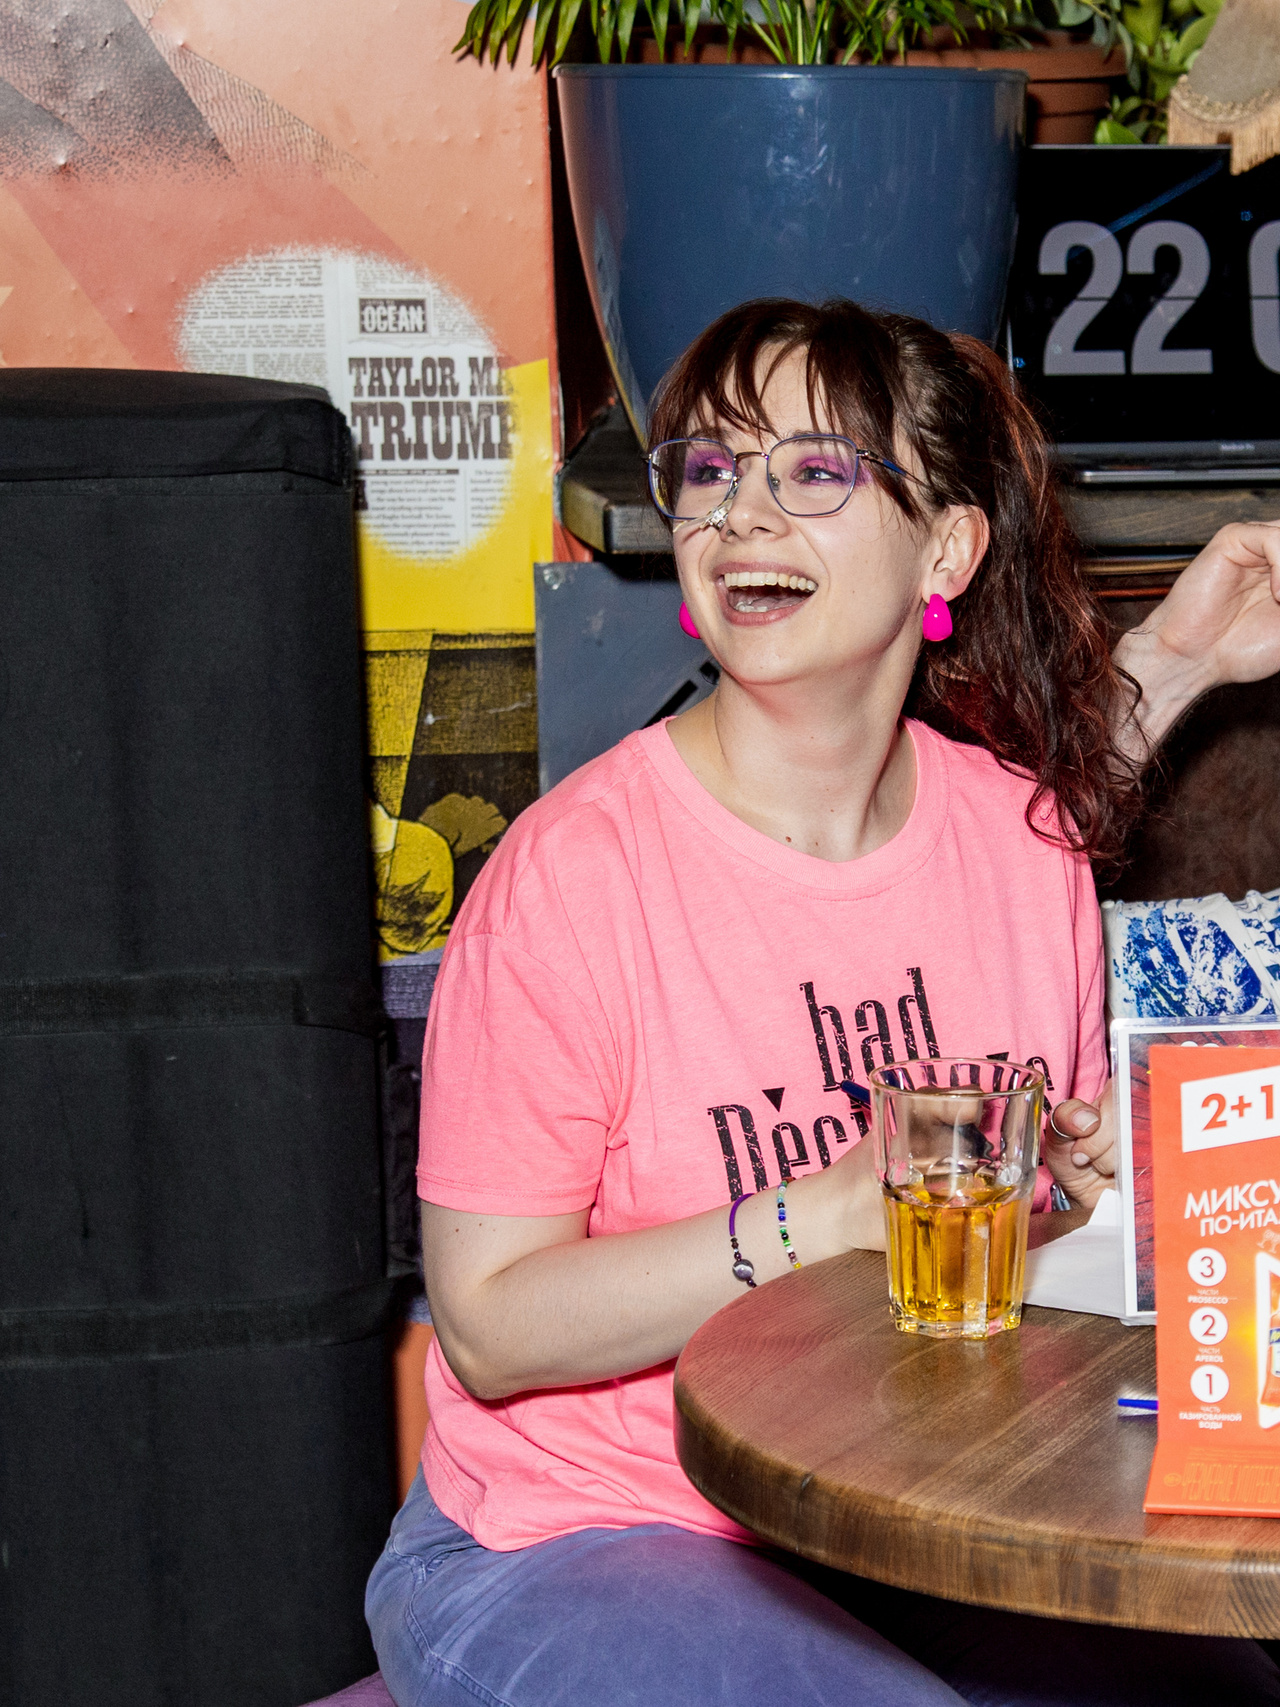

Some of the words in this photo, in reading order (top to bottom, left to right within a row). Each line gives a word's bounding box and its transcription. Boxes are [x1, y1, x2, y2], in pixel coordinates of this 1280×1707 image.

[1038, 219, 1213, 376] 22
[362, 304, 424, 333] OCEAN
[348, 357, 459, 397] TAYLOR
[799, 966, 941, 1093] bad
[1201, 1084, 1275, 1132] 2+1
[1200, 1255, 1215, 1278] 3
[1187, 1295, 1229, 1304] PROSECCO
[1200, 1314, 1217, 1337] 2
[1194, 1354, 1224, 1363] APEROL
[1205, 1373, 1213, 1395] 1
